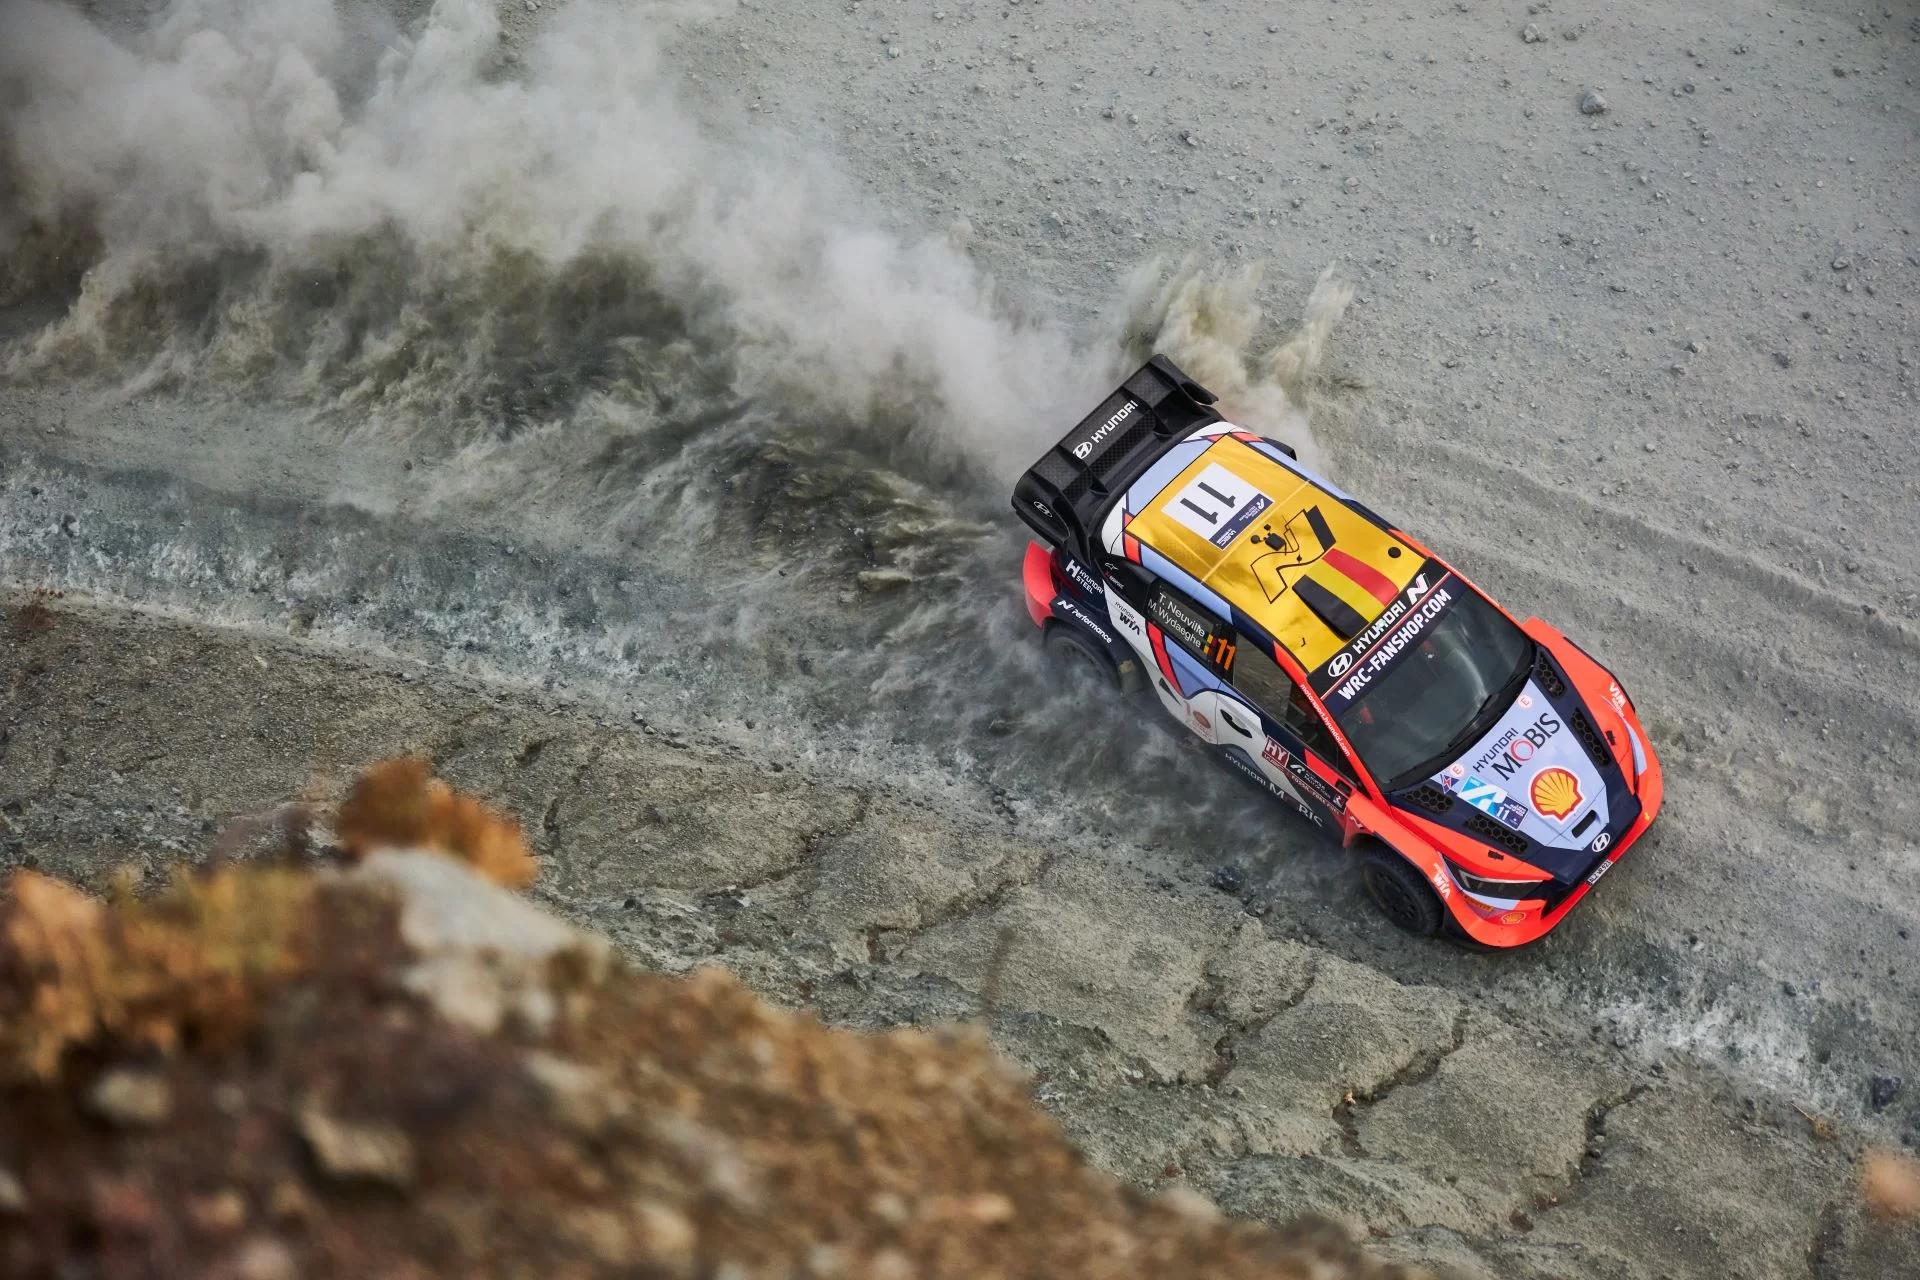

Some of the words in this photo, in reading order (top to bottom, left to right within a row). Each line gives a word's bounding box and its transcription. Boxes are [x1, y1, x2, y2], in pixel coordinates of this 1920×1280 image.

[1091, 400, 1139, 443] HYUNDAI
[1179, 481, 1236, 525] 11
[1075, 575, 1093, 594] STEEL
[1079, 570, 1104, 595] HYUNDAI
[1071, 608, 1112, 644] Performance
[1167, 601, 1206, 637] Neuville
[1214, 638, 1236, 671] 11
[1338, 588, 1452, 701] WRC-FANSHOP.COM
[1300, 684, 1351, 757] motorsport.hyundai.com
[1266, 741, 1287, 761] HY
[1472, 727, 1519, 773] HYUNDAI
[1491, 712, 1561, 781] MOBIS
[1496, 806, 1510, 821] 11
